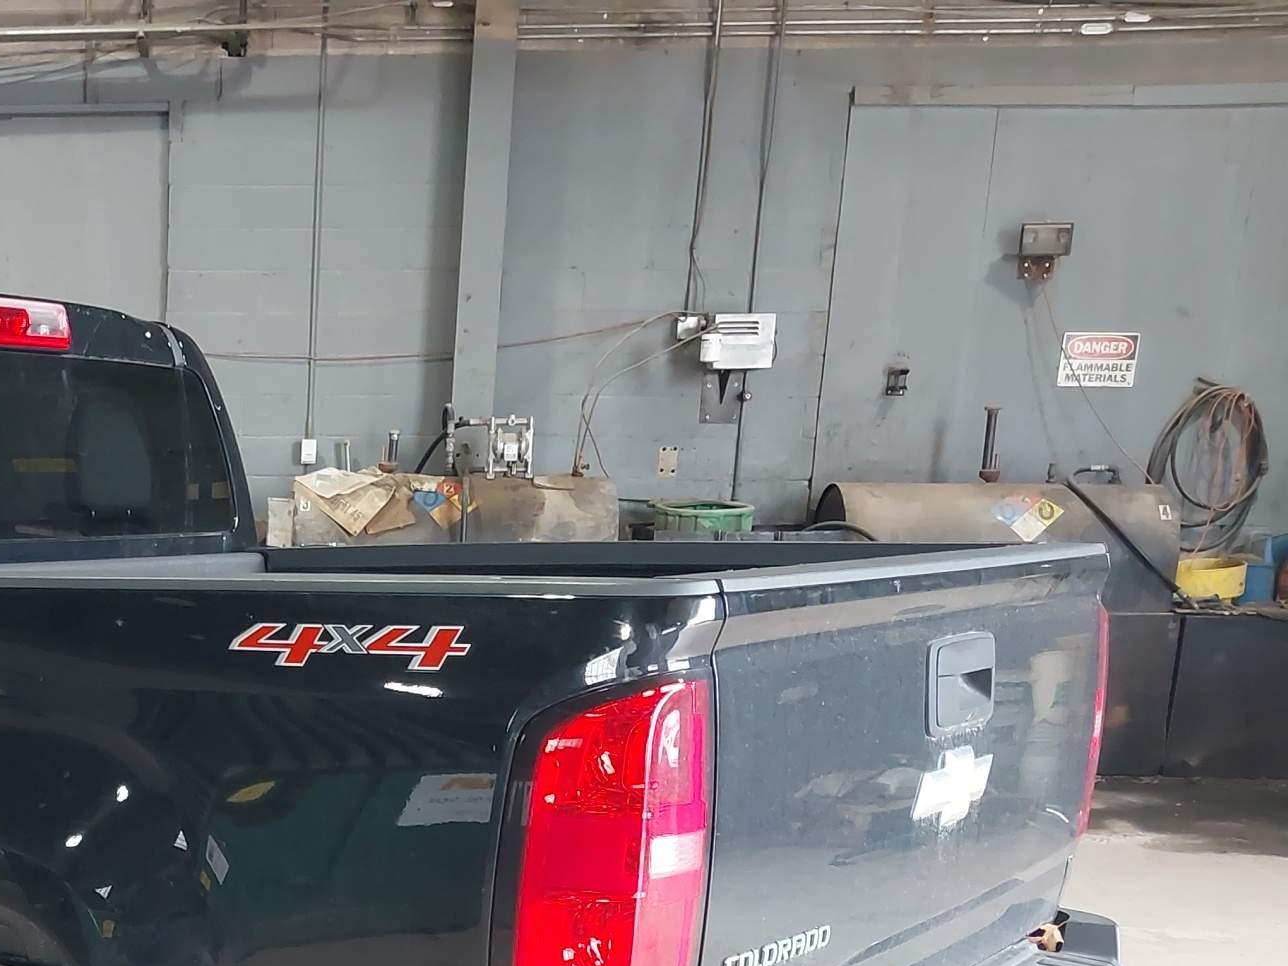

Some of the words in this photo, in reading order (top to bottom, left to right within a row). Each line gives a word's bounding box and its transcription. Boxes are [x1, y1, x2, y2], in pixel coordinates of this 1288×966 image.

[1073, 341, 1129, 354] DANGER
[1063, 362, 1133, 372] FLAMMABLE
[1064, 374, 1127, 383] MATERIALS
